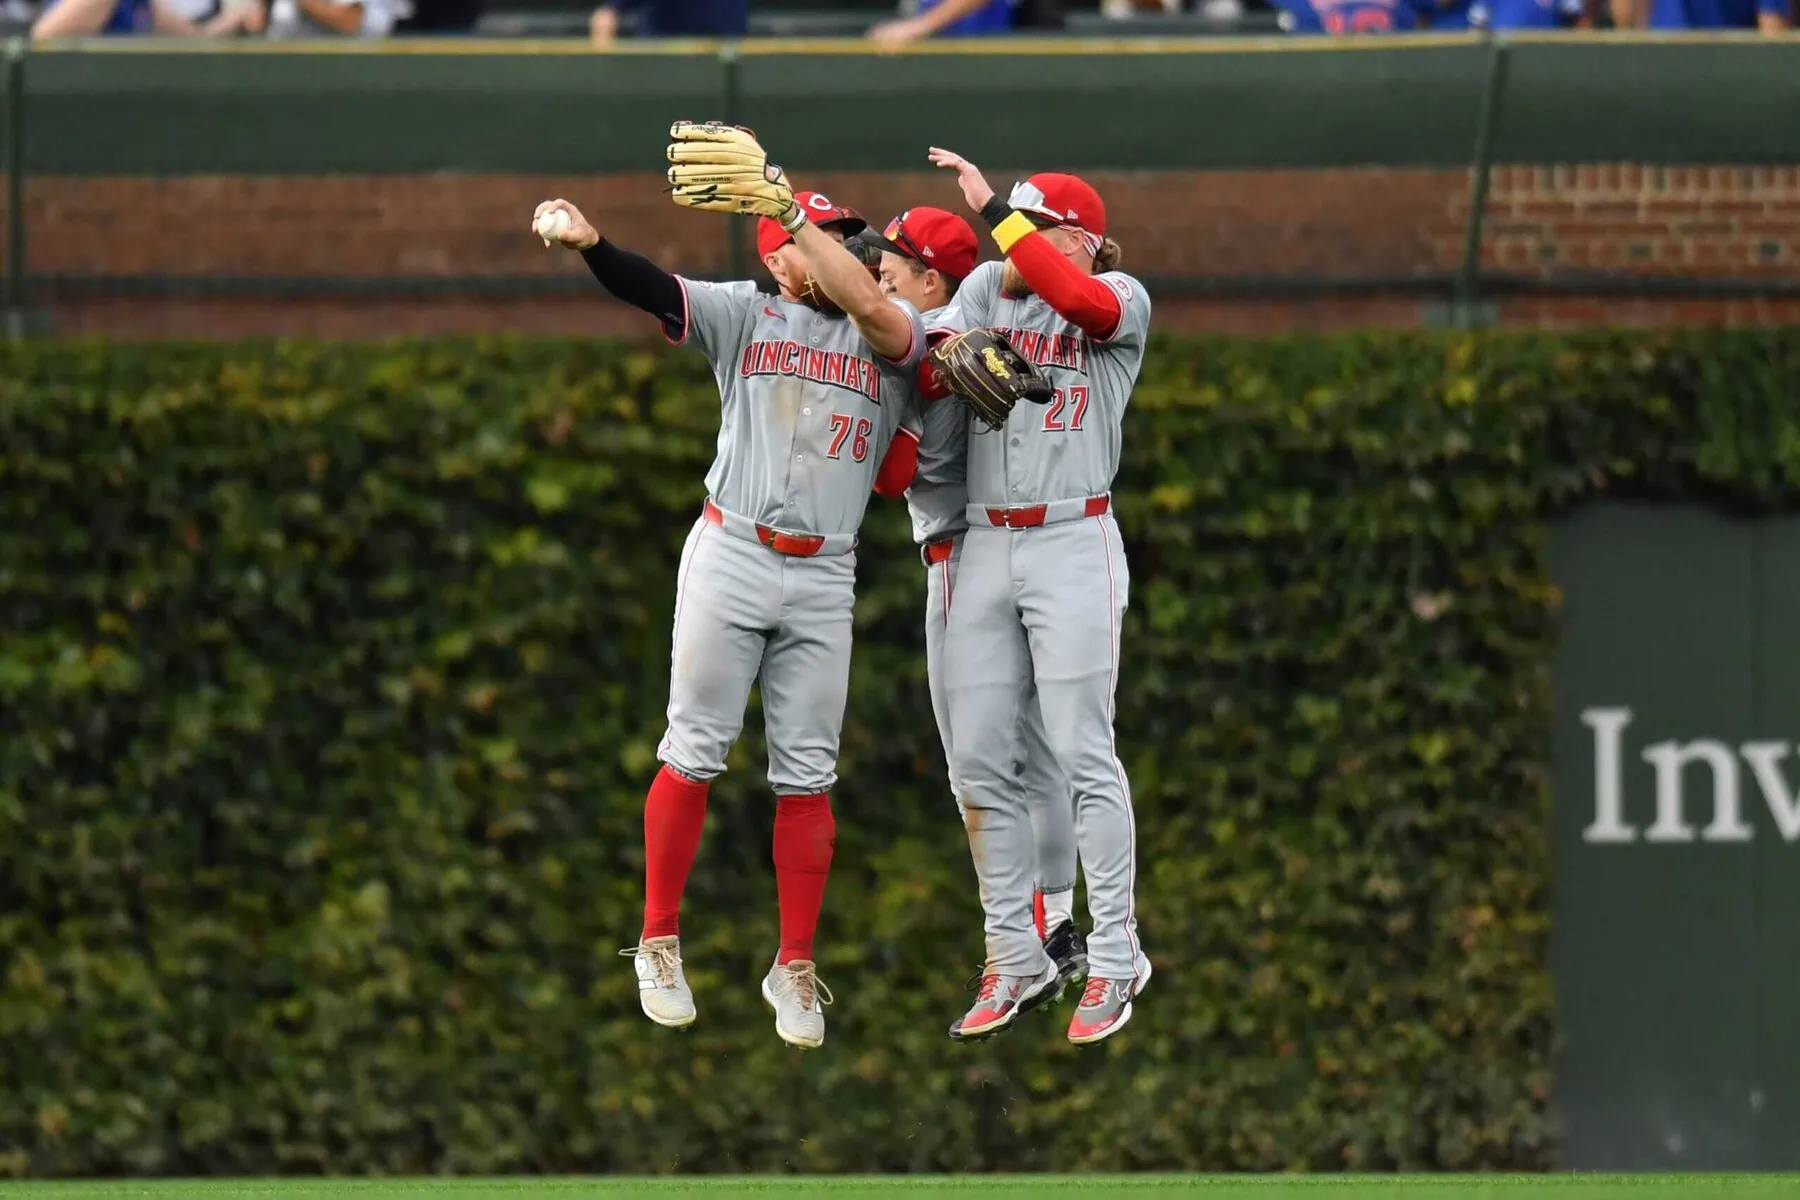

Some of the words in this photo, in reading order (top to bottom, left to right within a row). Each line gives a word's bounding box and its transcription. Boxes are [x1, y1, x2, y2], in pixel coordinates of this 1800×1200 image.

[808, 194, 832, 211] C
[1042, 385, 1089, 432] 27
[826, 412, 872, 462] 76
[1580, 705, 1800, 843] Inv
